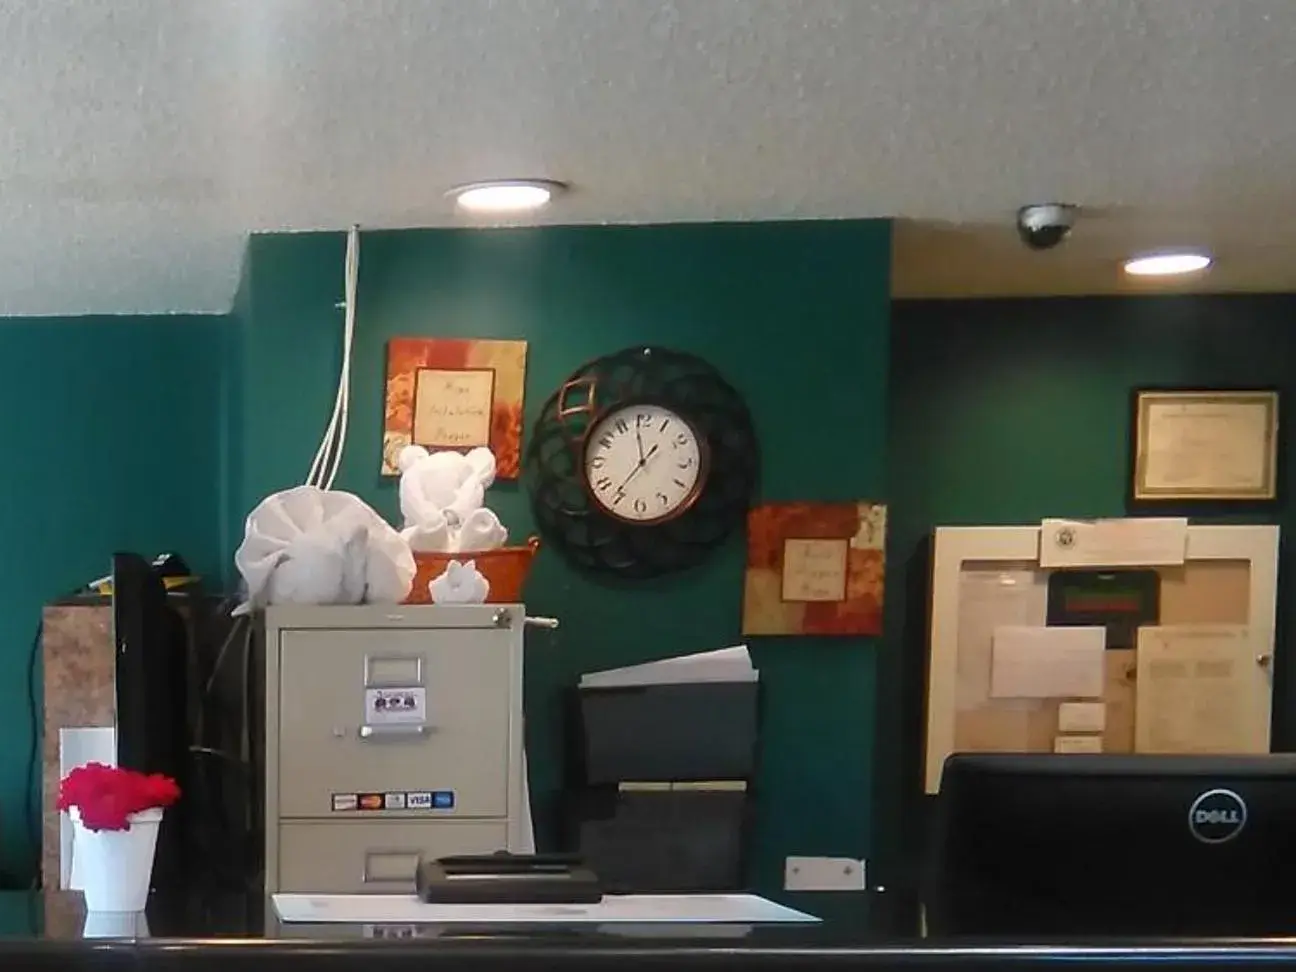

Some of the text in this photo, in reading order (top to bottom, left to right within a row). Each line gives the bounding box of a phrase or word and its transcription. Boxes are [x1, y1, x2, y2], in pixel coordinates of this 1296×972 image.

[659, 419, 669, 432] 1
[633, 499, 647, 513] 6
[1195, 809, 1240, 824] DELL
